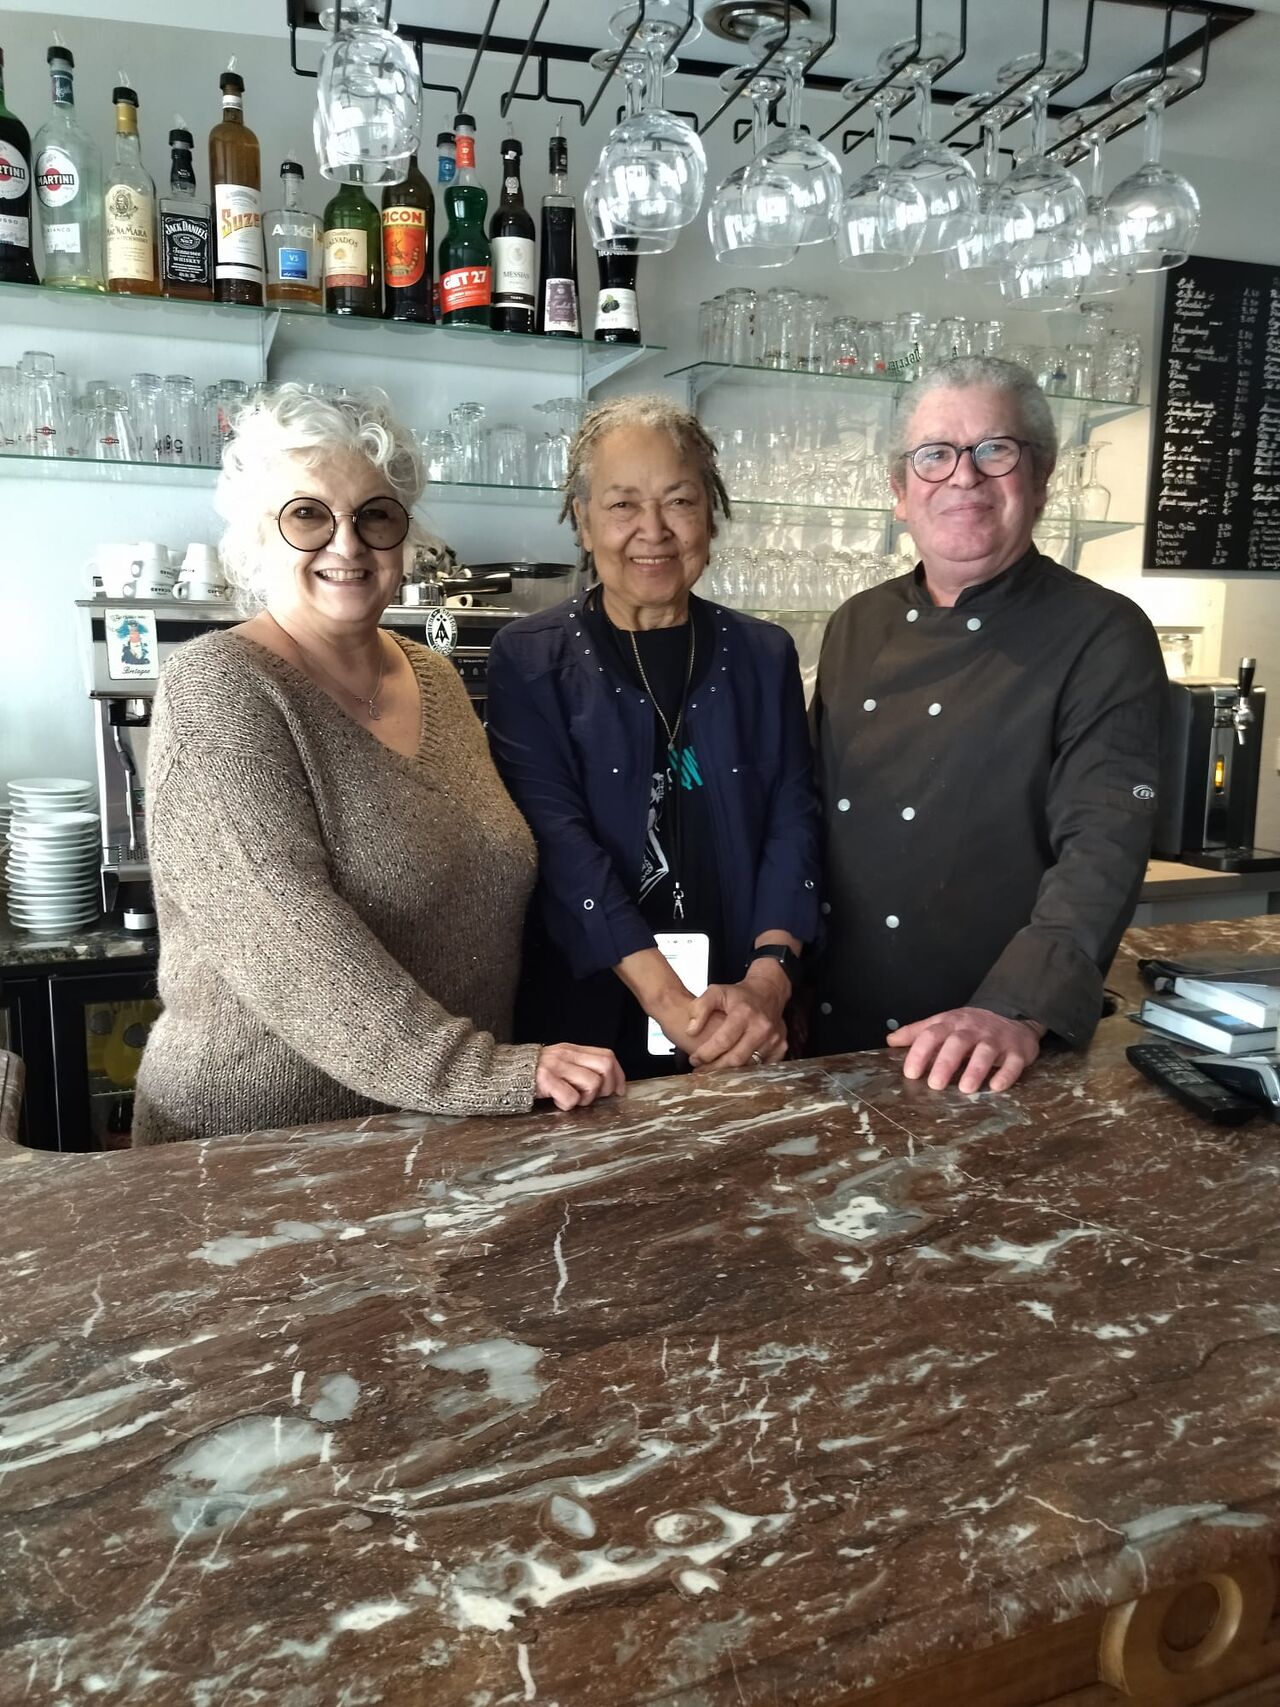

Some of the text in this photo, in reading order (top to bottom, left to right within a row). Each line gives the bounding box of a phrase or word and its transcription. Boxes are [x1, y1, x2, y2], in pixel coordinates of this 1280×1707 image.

[37, 174, 74, 186] MARTINI
[165, 222, 183, 236] JACK
[443, 270, 487, 290] GET 27
